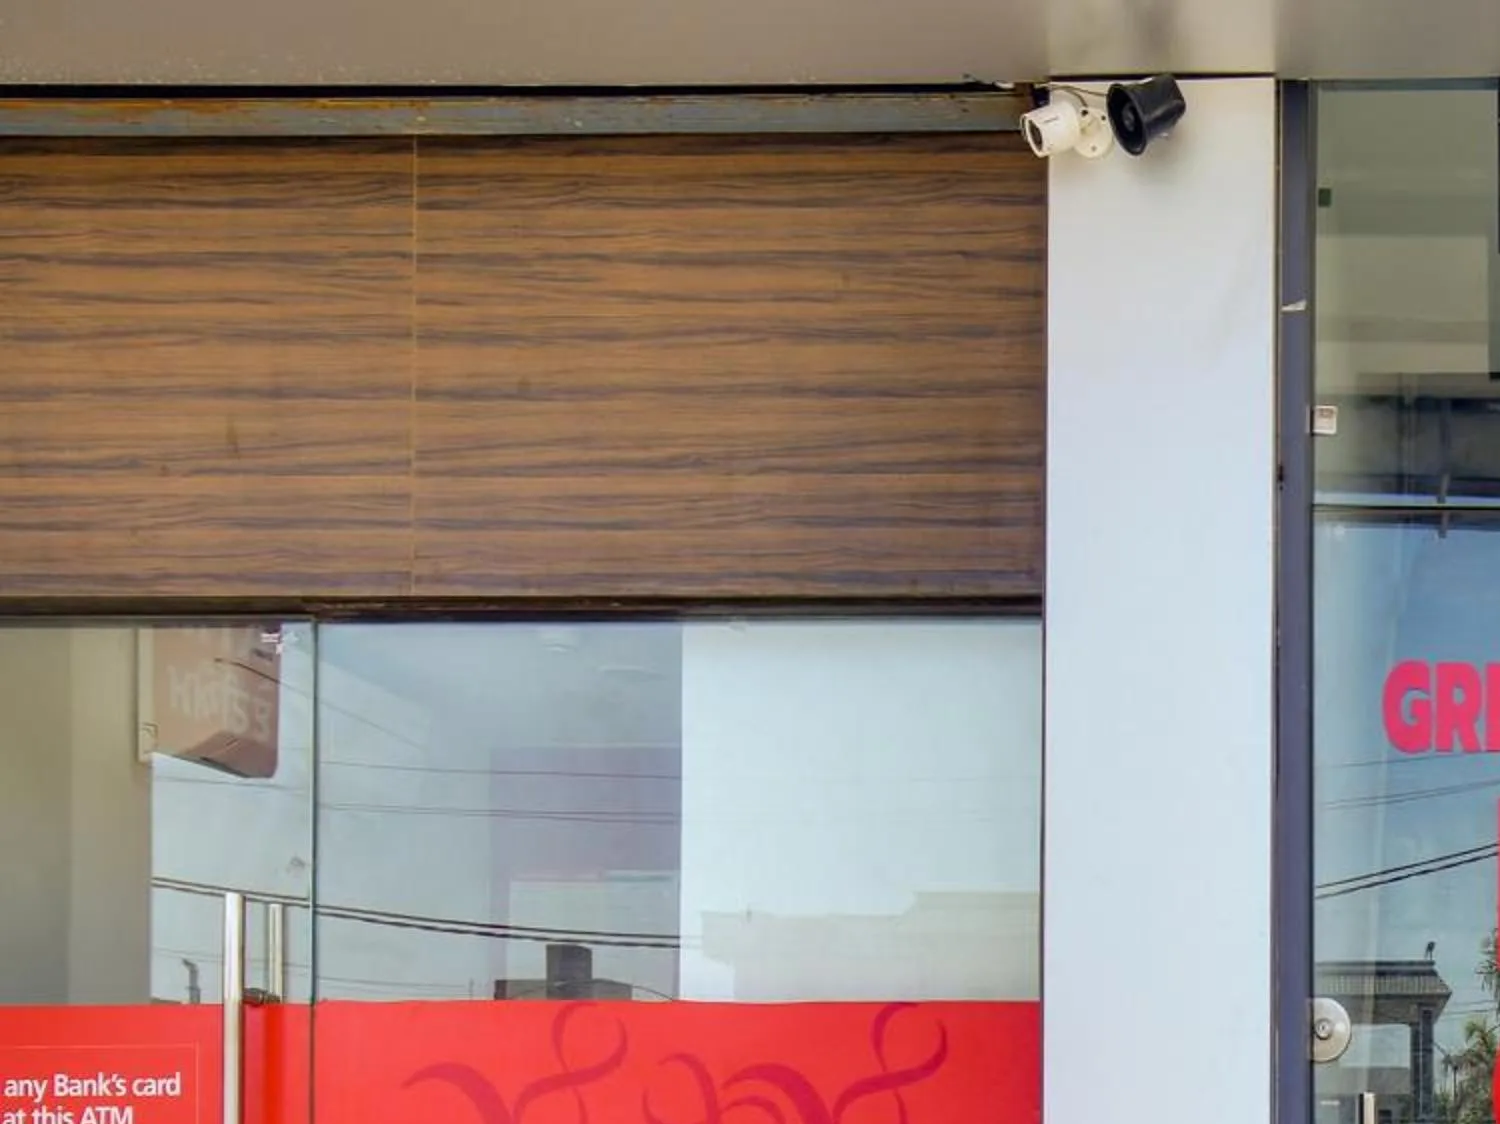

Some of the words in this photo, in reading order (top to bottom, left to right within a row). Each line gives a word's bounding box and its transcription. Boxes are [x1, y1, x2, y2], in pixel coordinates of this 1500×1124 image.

[4, 1078, 48, 1103] any
[53, 1072, 127, 1097] Bank's
[132, 1072, 182, 1097] card
